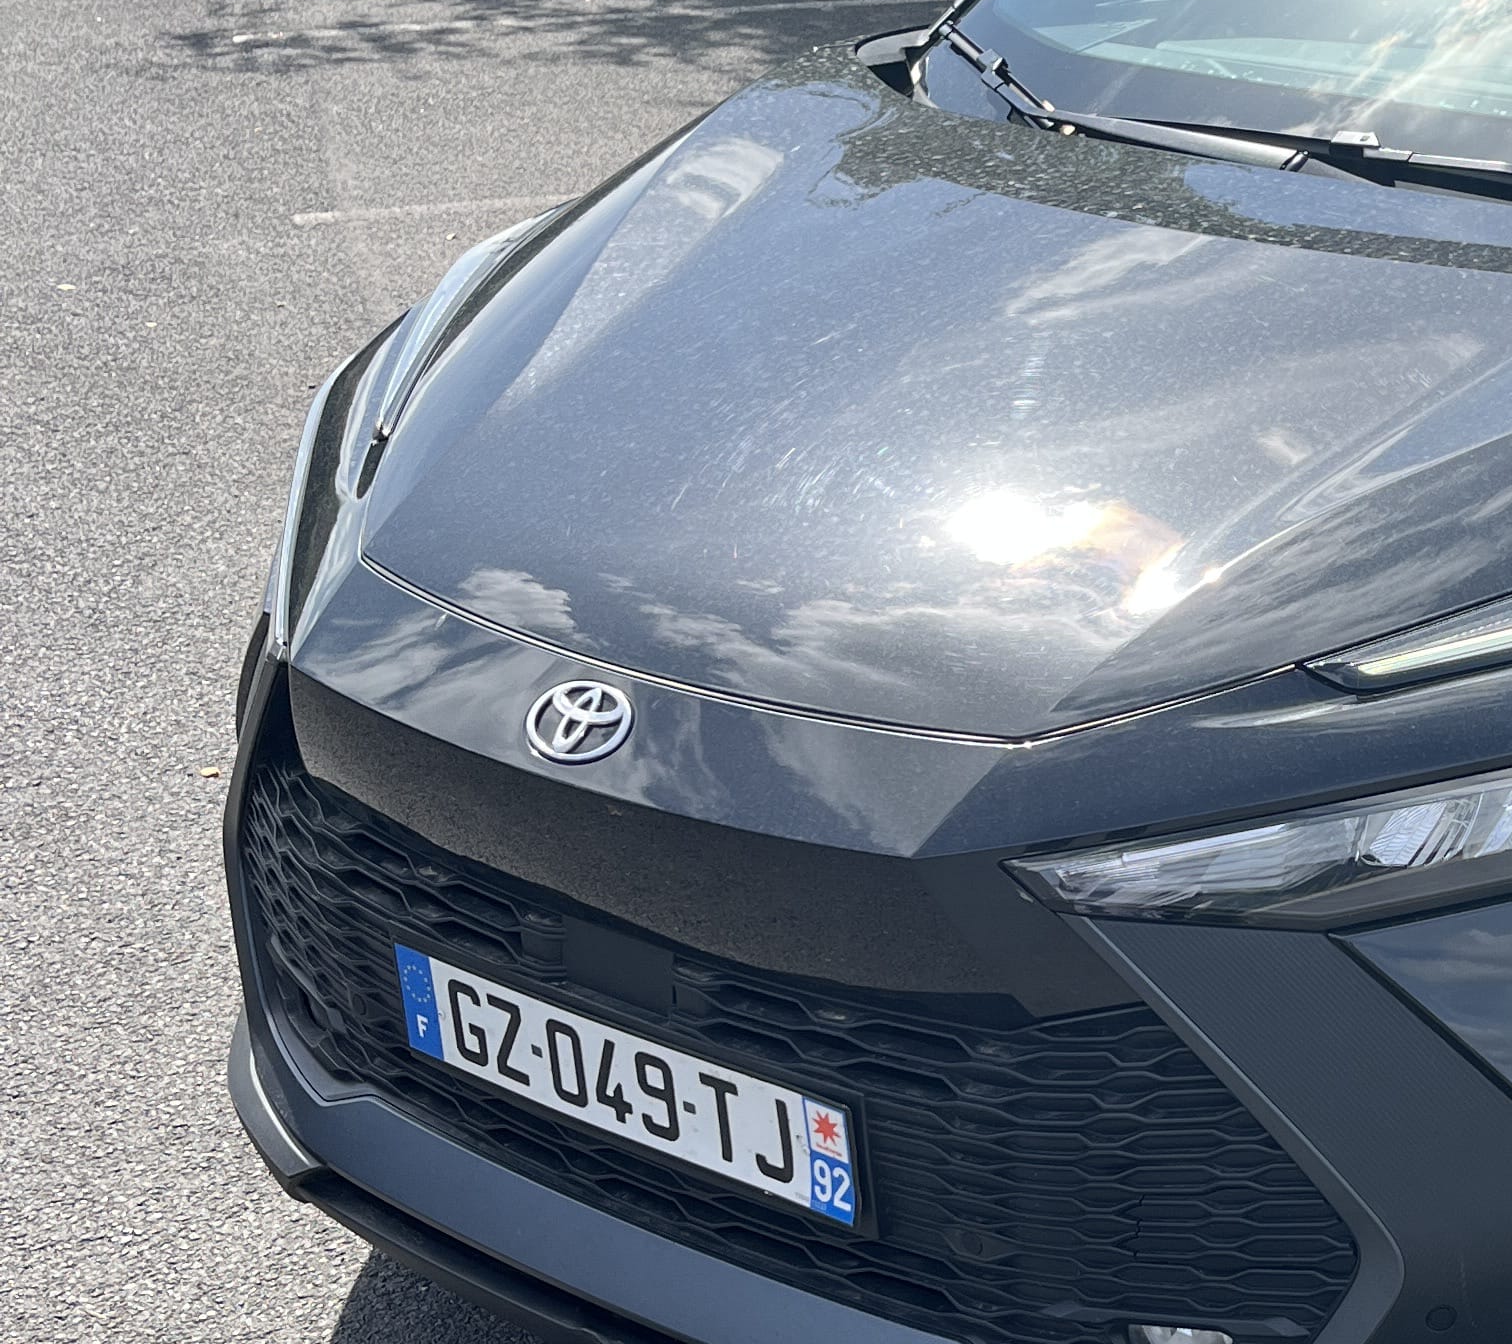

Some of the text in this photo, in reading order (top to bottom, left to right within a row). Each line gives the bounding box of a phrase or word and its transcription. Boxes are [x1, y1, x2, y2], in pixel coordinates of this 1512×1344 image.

[416, 1014, 428, 1038] F
[447, 979, 794, 1184] GZ-049-TJ
[813, 1159, 852, 1212] 92
